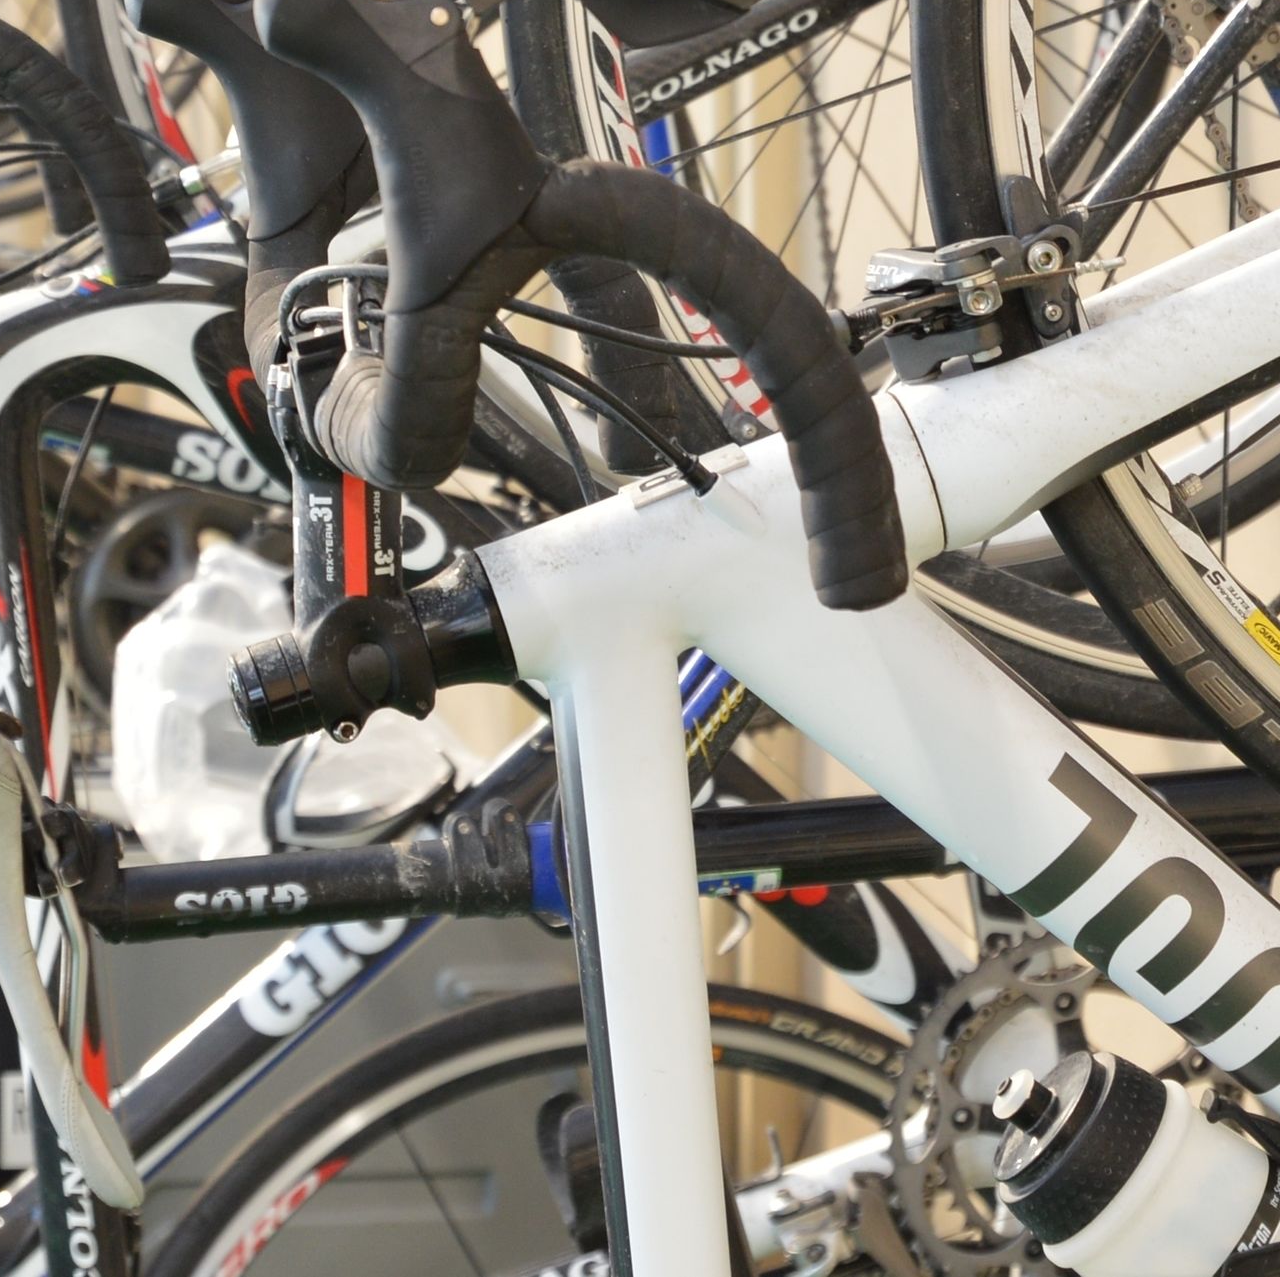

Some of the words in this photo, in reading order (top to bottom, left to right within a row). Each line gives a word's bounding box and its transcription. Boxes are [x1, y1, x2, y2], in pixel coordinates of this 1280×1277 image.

[632, 7, 819, 115] COLNAGO
[308, 492, 334, 523] 3T
[373, 548, 396, 577] 3T
[238, 918, 408, 1037] GIO
